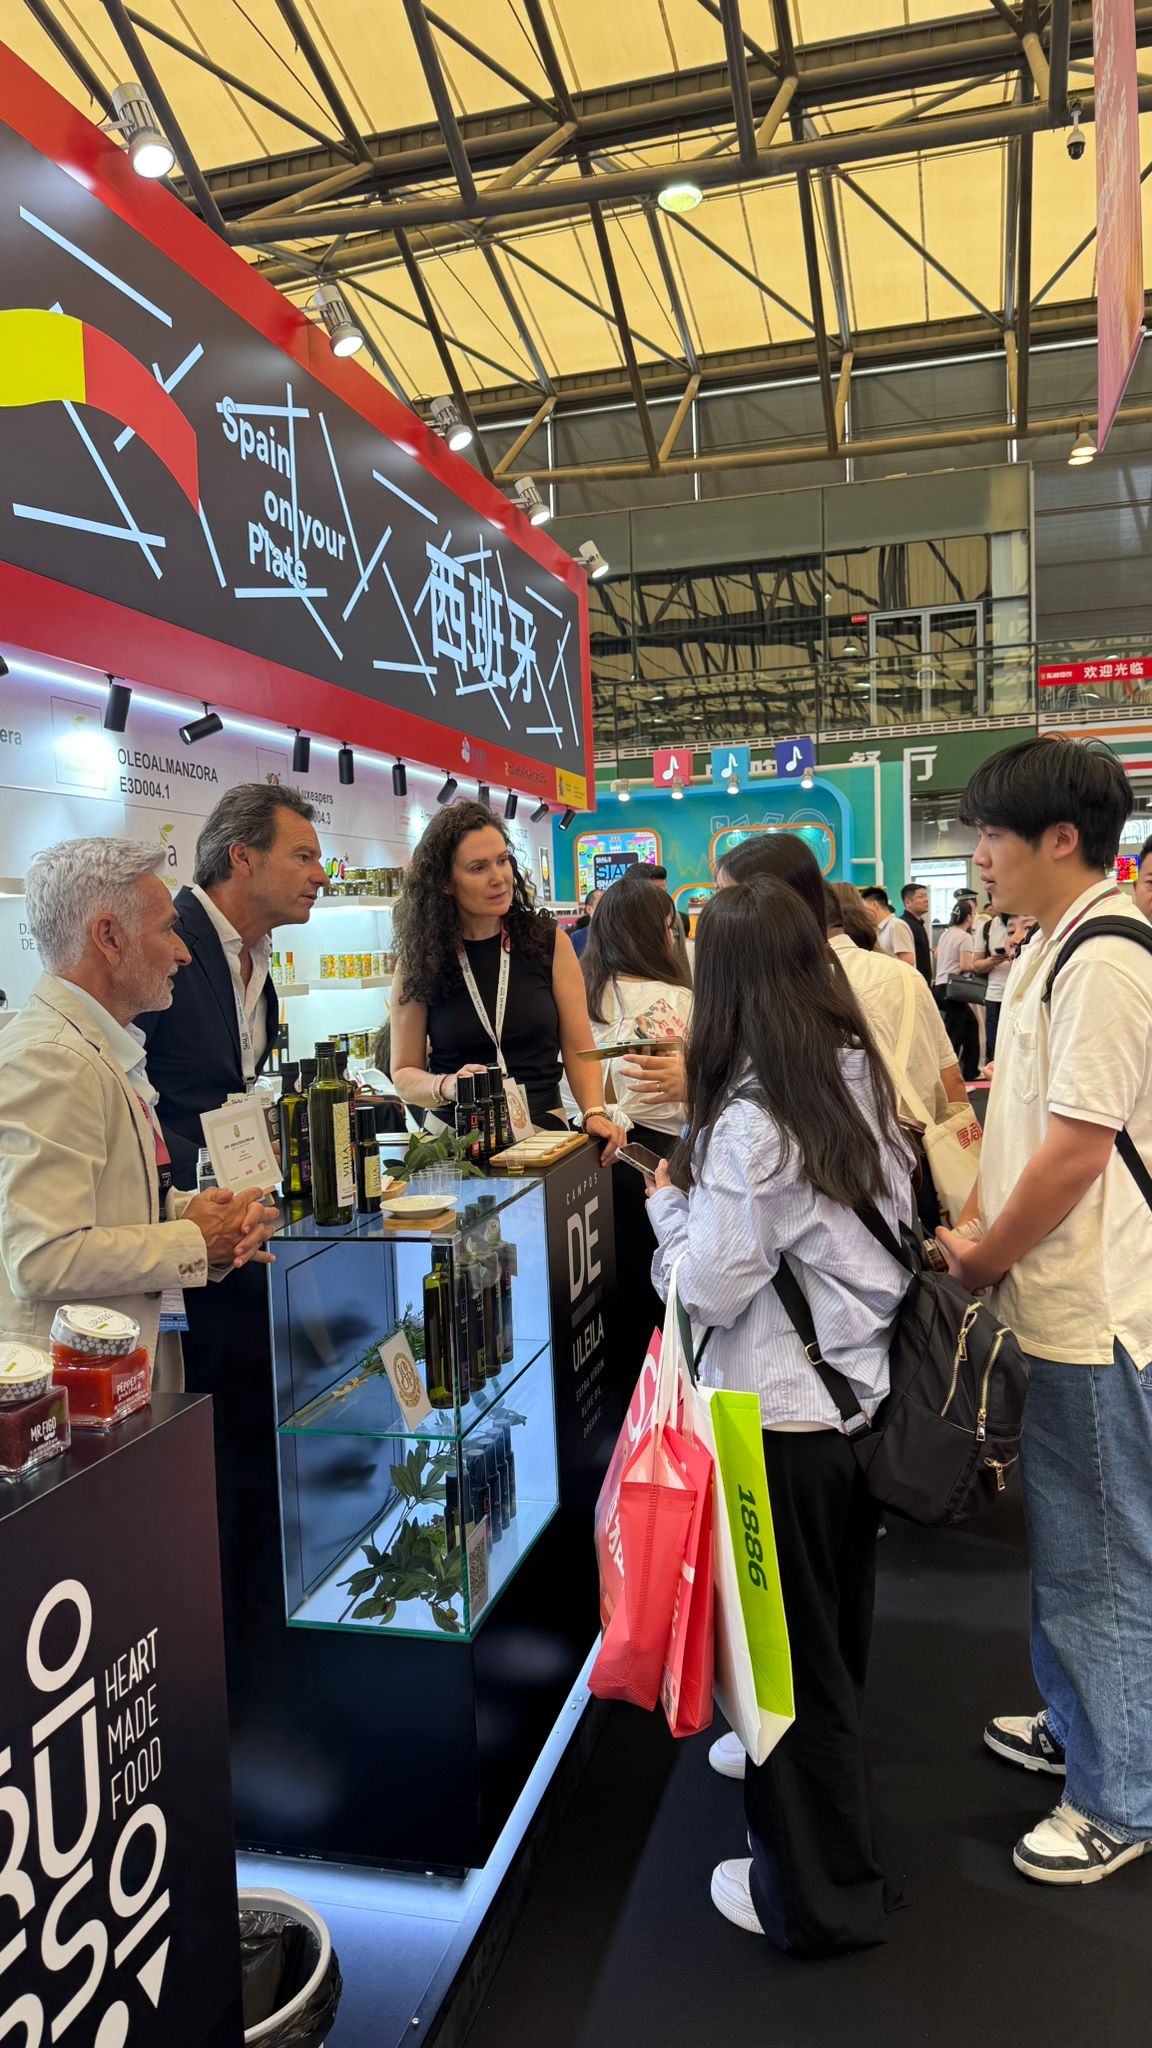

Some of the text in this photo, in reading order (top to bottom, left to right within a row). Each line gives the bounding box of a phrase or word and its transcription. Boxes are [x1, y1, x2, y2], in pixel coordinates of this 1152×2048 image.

[222, 395, 292, 479] Spain
[264, 490, 346, 561] on your
[425, 540, 537, 704] 西班牙
[1083, 661, 1144, 679] 欢迎光临
[117, 747, 219, 783] OLEOALMANZORA
[119, 776, 171, 800] E3D004.1
[566, 1172, 598, 1206] CAMPOS
[567, 1195, 602, 1304] DE
[572, 1312, 605, 1373] ULEILA
[737, 1482, 768, 1592] 1886
[105, 1626, 159, 1709] HEART
[107, 1683, 159, 1765] MADE
[110, 1736, 162, 1821] FOOD
